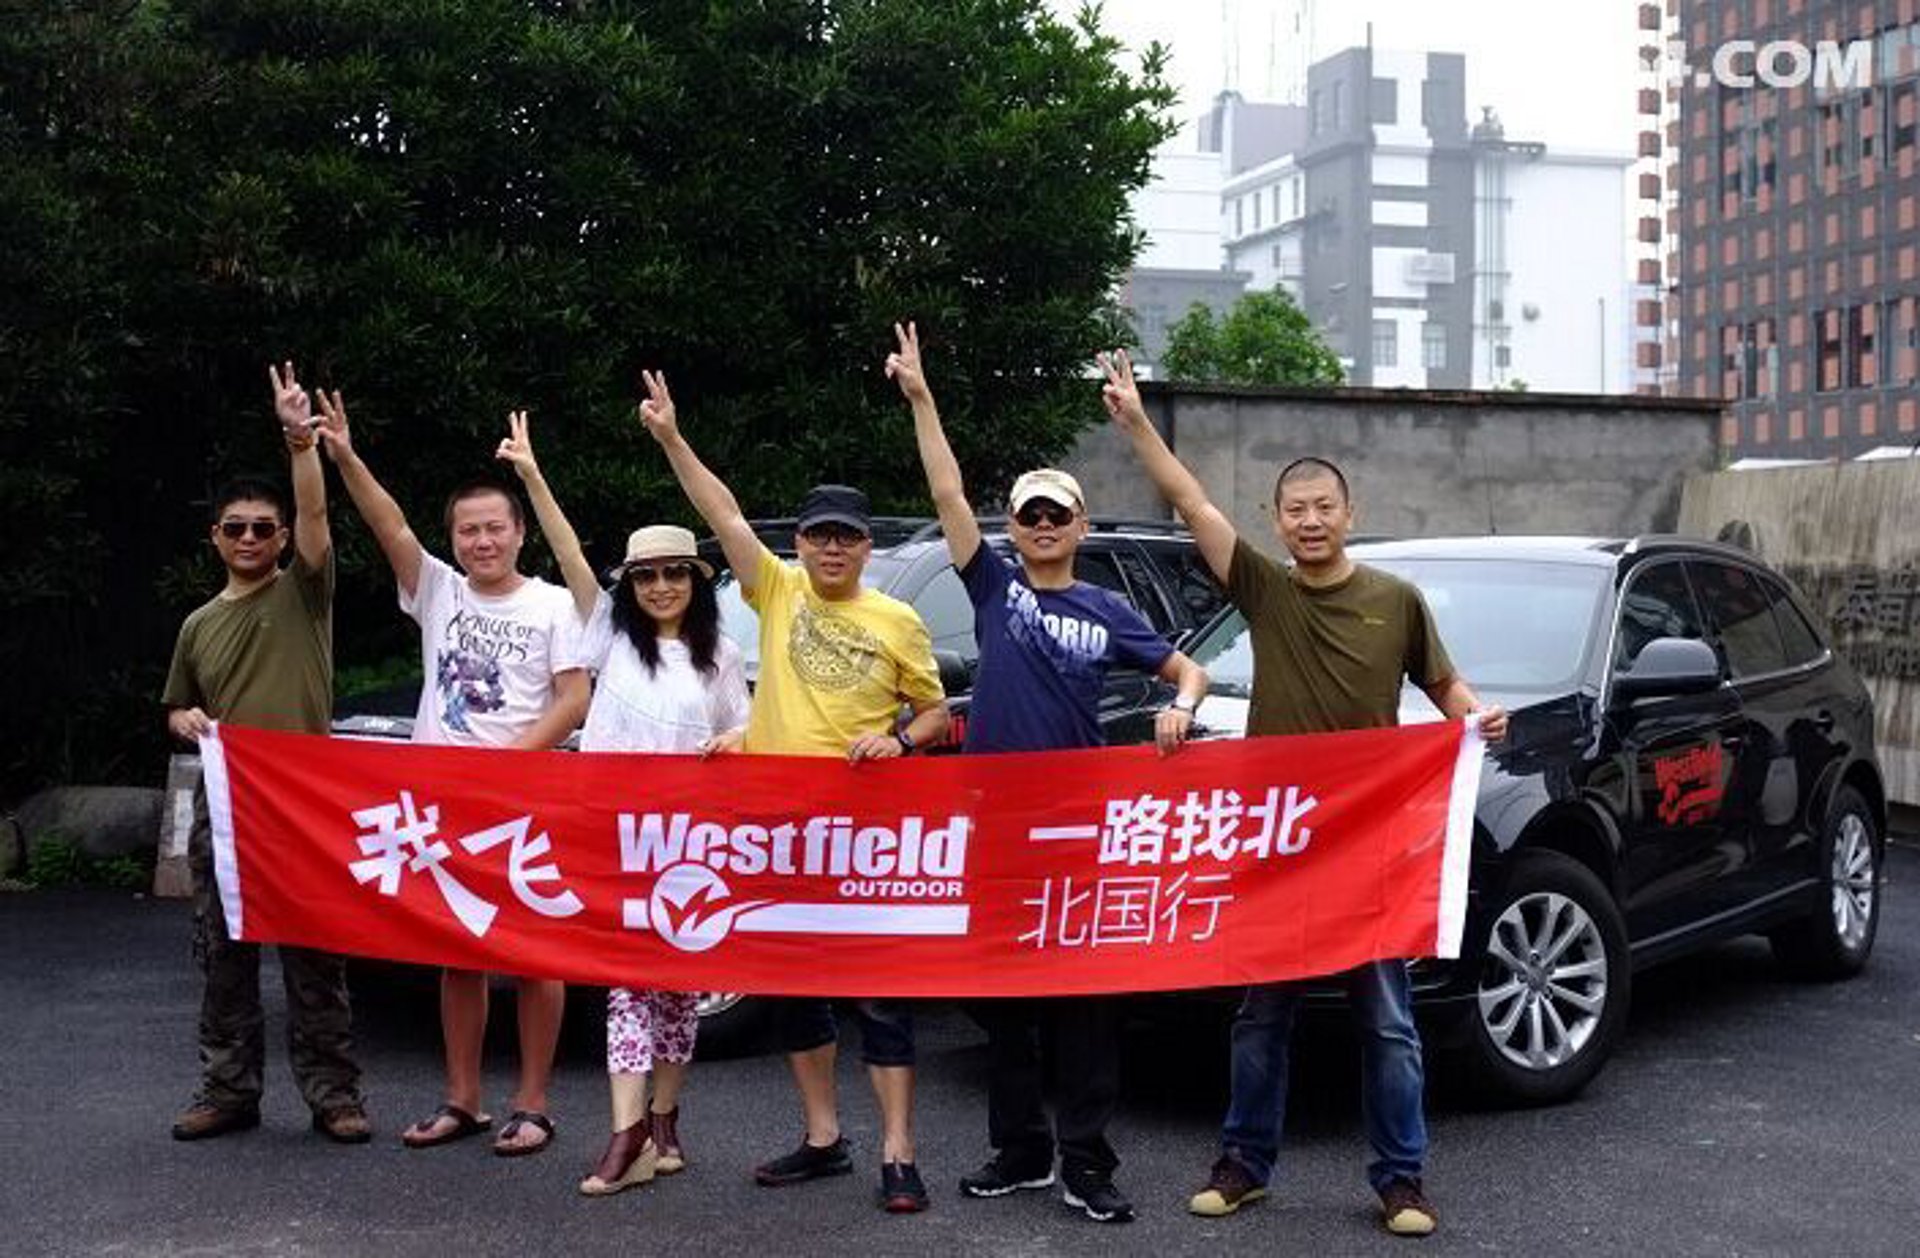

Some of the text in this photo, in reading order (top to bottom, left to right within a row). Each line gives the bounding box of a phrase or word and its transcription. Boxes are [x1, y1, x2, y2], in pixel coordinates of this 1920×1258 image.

[348, 790, 585, 938] 我飞
[617, 812, 969, 877] Westfield
[1028, 786, 1319, 866] 一路找北
[838, 880, 963, 898] OUTDOOR
[1017, 871, 1235, 949] 北国行
